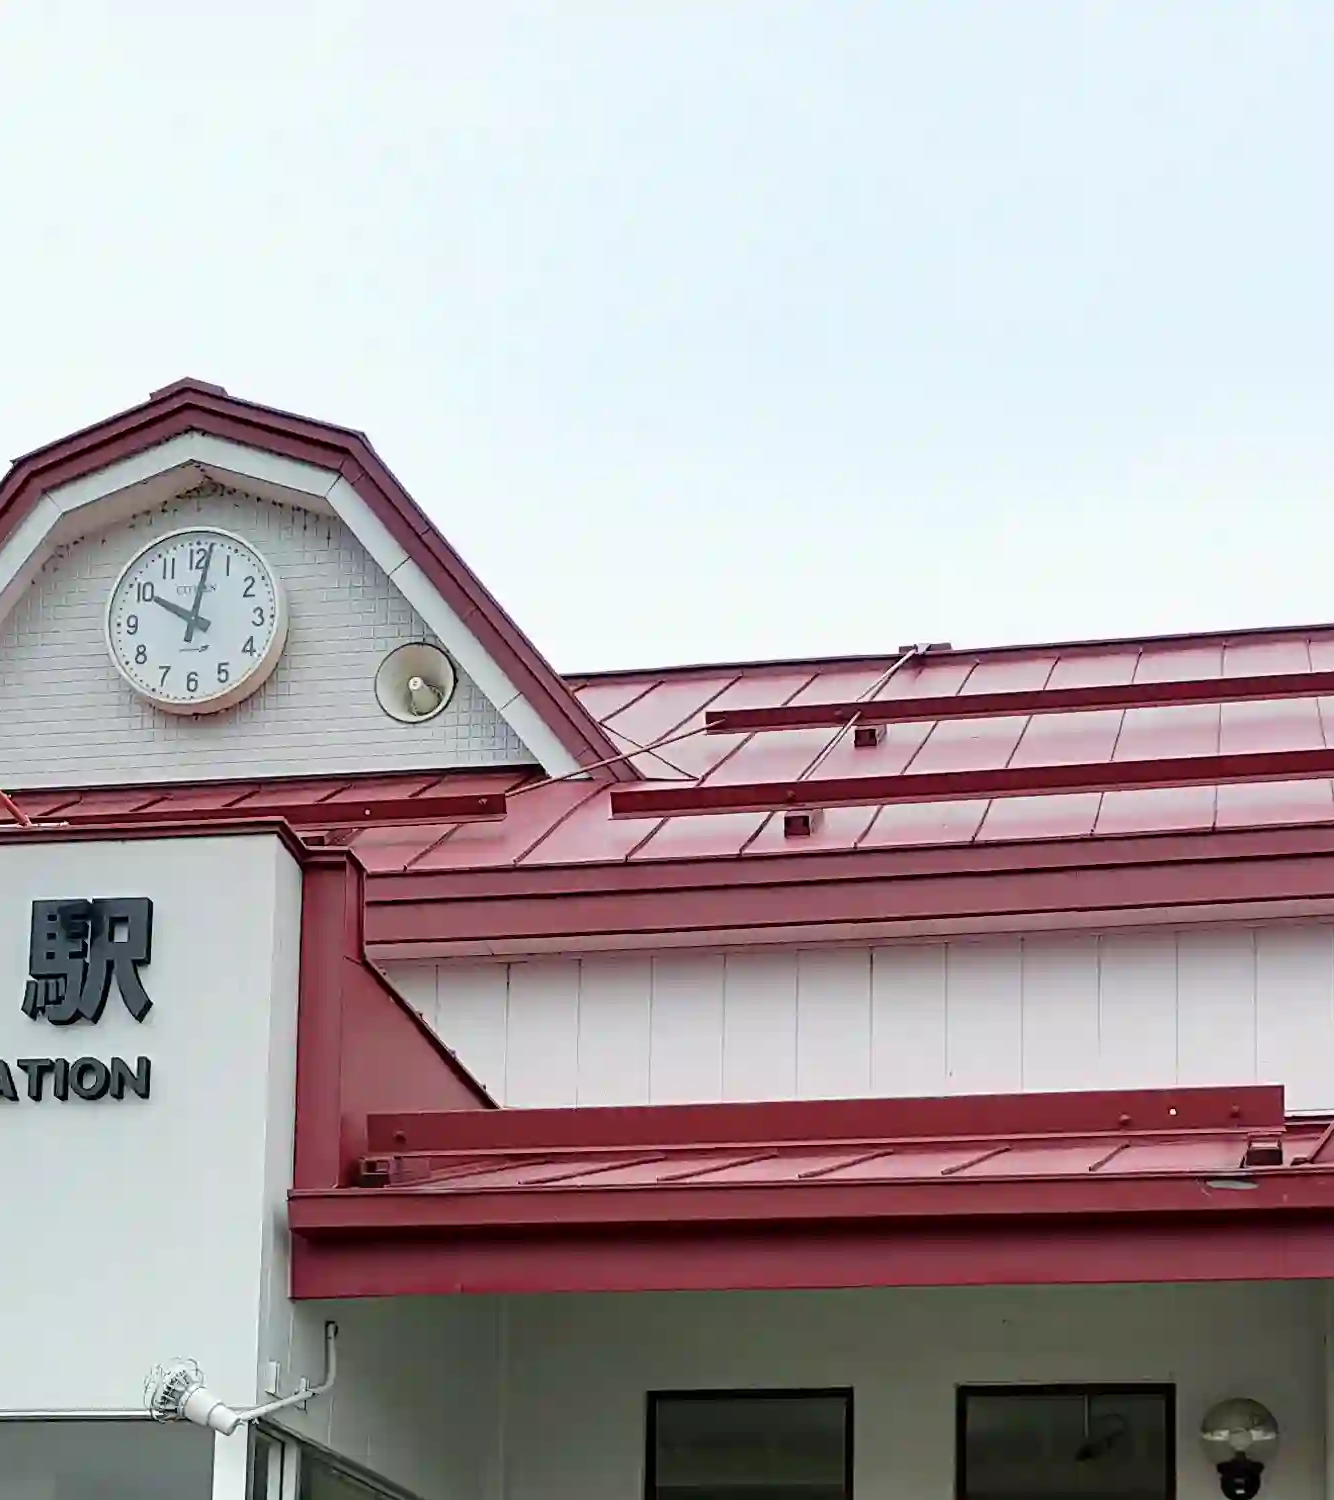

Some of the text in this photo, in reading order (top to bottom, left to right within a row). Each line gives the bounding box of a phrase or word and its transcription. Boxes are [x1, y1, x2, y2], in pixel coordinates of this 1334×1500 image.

[162, 557, 176, 580] 11
[189, 548, 207, 571] 12
[136, 581, 155, 603] 10
[242, 575, 256, 598] 2
[126, 614, 139, 635] 9
[251, 606, 265, 627] 3
[134, 644, 148, 665] 8
[241, 636, 256, 657] 4
[158, 666, 171, 687] 7
[186, 672, 199, 693] 6
[217, 662, 230, 683] 5
